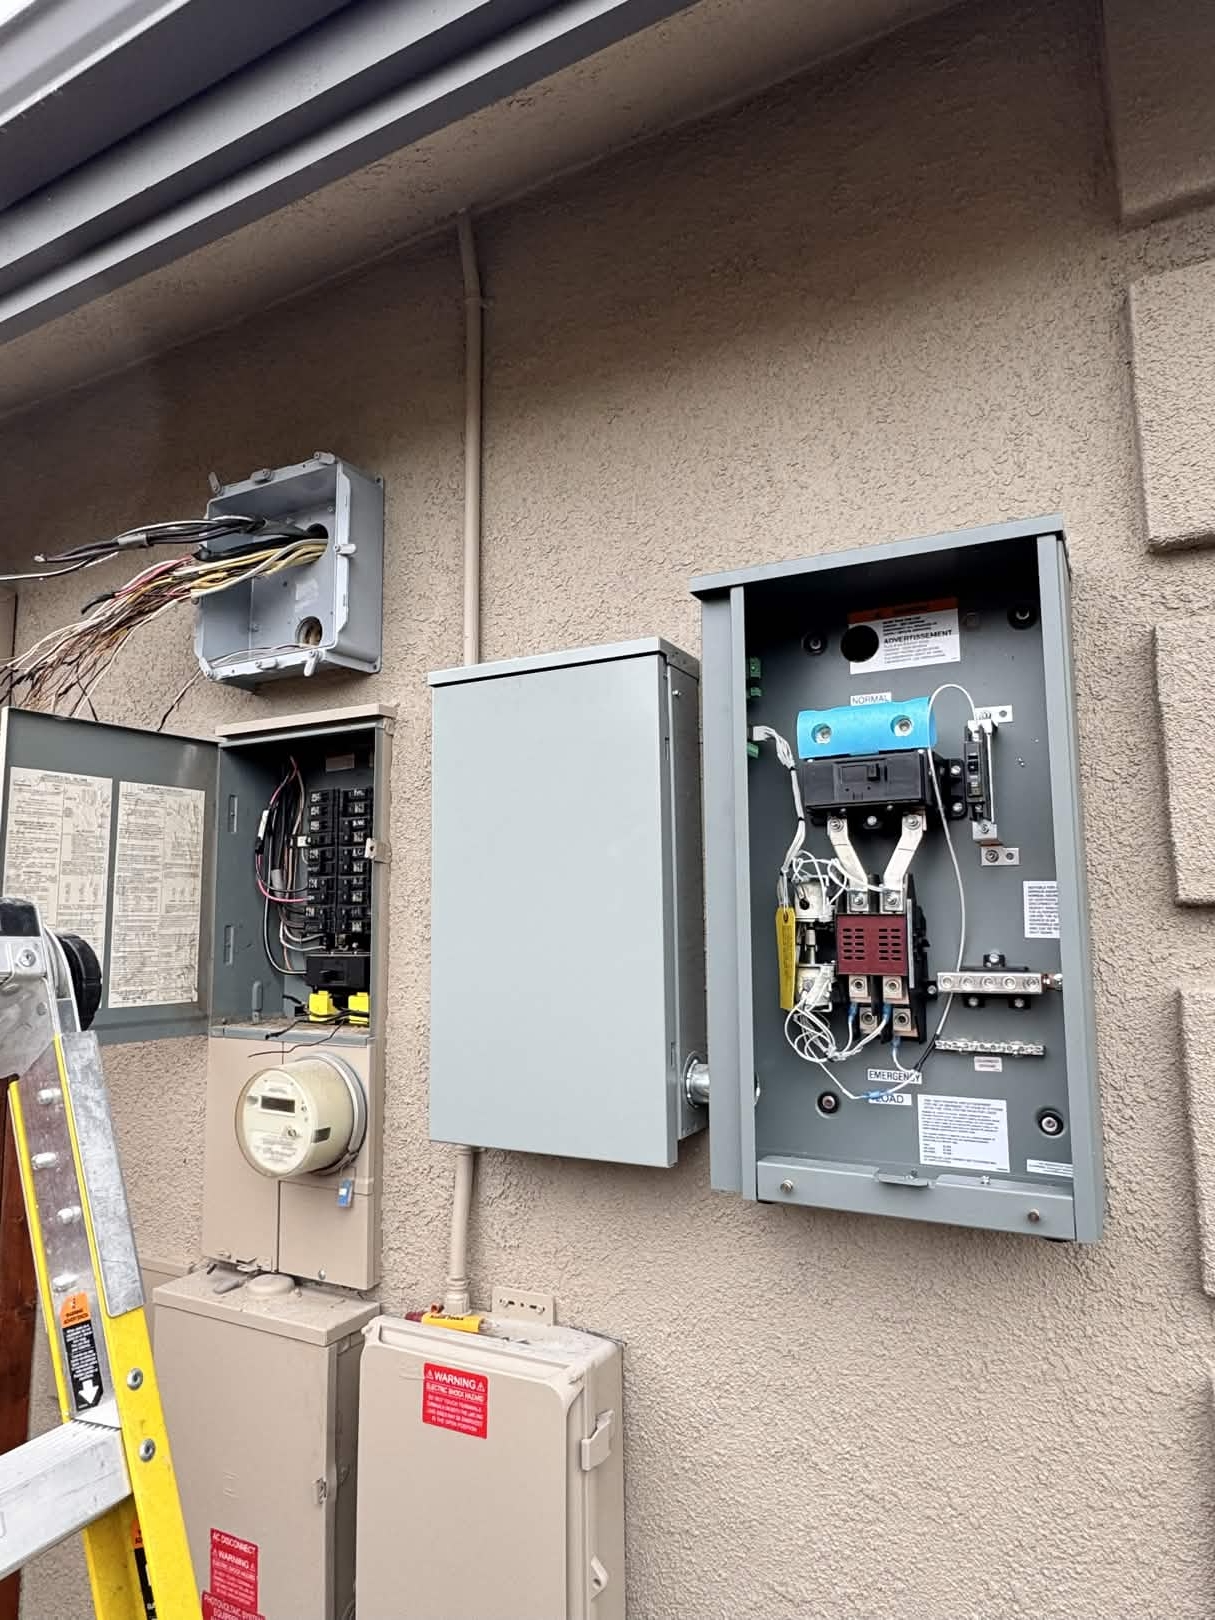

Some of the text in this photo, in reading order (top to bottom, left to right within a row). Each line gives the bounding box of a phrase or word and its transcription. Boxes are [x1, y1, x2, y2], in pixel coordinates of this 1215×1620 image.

[852, 694, 889, 705] NORMAL
[434, 1371, 477, 1390] WARNING
[219, 1551, 249, 1569] WARNING
